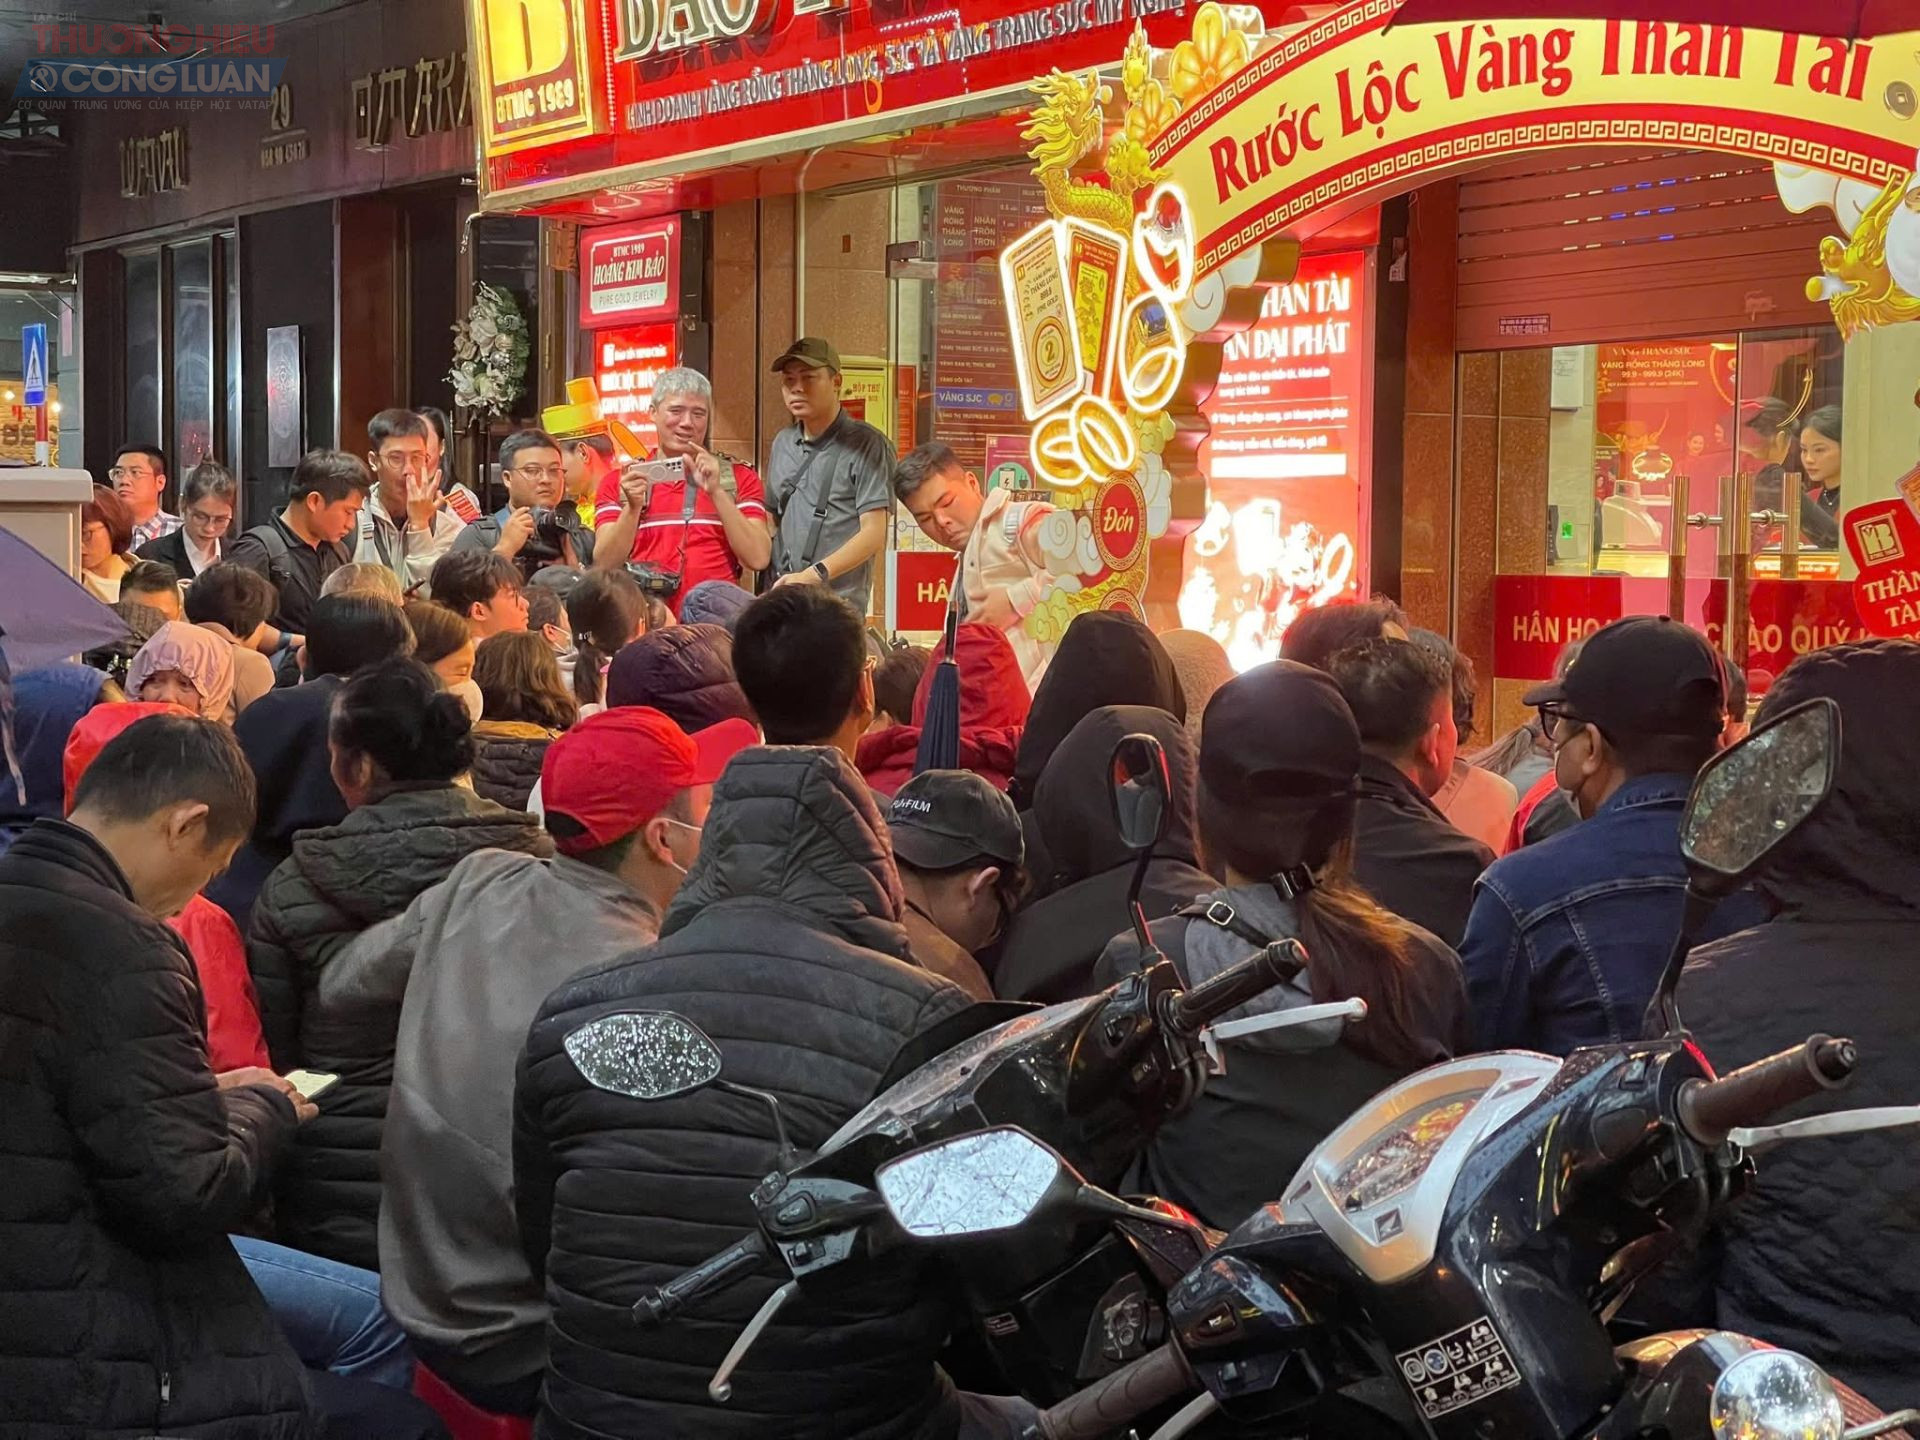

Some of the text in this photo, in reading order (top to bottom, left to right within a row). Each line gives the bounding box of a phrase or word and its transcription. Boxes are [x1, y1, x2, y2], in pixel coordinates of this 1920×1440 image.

[654, 90, 702, 124] DOANH
[703, 79, 739, 115] VÀNG
[990, 6, 1053, 50] TRANG
[495, 78, 574, 124] BTMC 1989
[1208, 101, 1324, 204] Rước
[1334, 60, 1422, 140] Lộc
[1434, 24, 1575, 100] Vàng
[944, 205, 965, 215] VÀNG
[943, 239, 964, 247] LONG
[625, 258, 643, 281] KIM
[644, 249, 665, 279] BẢO
[614, 292, 631, 305] GOLD
[1313, 272, 1351, 313] TÀI
[1045, 340, 1055, 362] 2
[1253, 325, 1289, 364] ĐẠI
[1292, 318, 1351, 357] PHÁT
[1682, 360, 1705, 368] LONG
[939, 391, 983, 403] VÀNG SJC
[1103, 506, 1134, 533] Đón
[1512, 610, 1561, 643] HÂN
[1791, 619, 1851, 655] QUÝ
